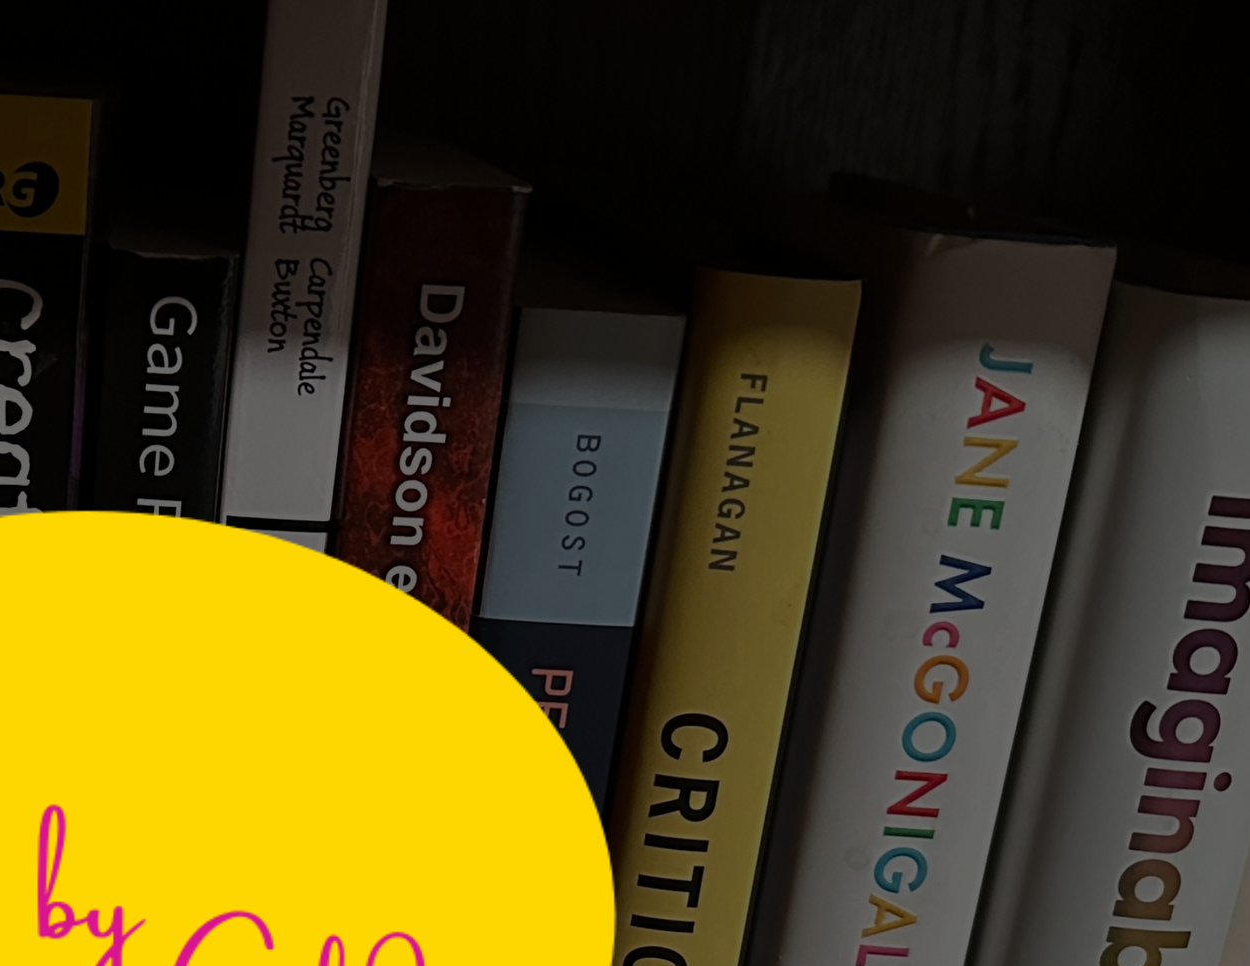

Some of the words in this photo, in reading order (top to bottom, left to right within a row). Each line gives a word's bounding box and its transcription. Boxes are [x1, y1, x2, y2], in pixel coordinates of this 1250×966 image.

[271, 96, 316, 236] Marquardt
[314, 96, 350, 233] Greenberg
[265, 259, 300, 353] Buxton
[296, 257, 333, 397] Carpendale
[137, 295, 199, 478] Game
[388, 282, 467, 548] Davidson
[947, 342, 1034, 530] JANE
[556, 433, 602, 577] BOGOST
[707, 372, 769, 573] FLANAGAN
